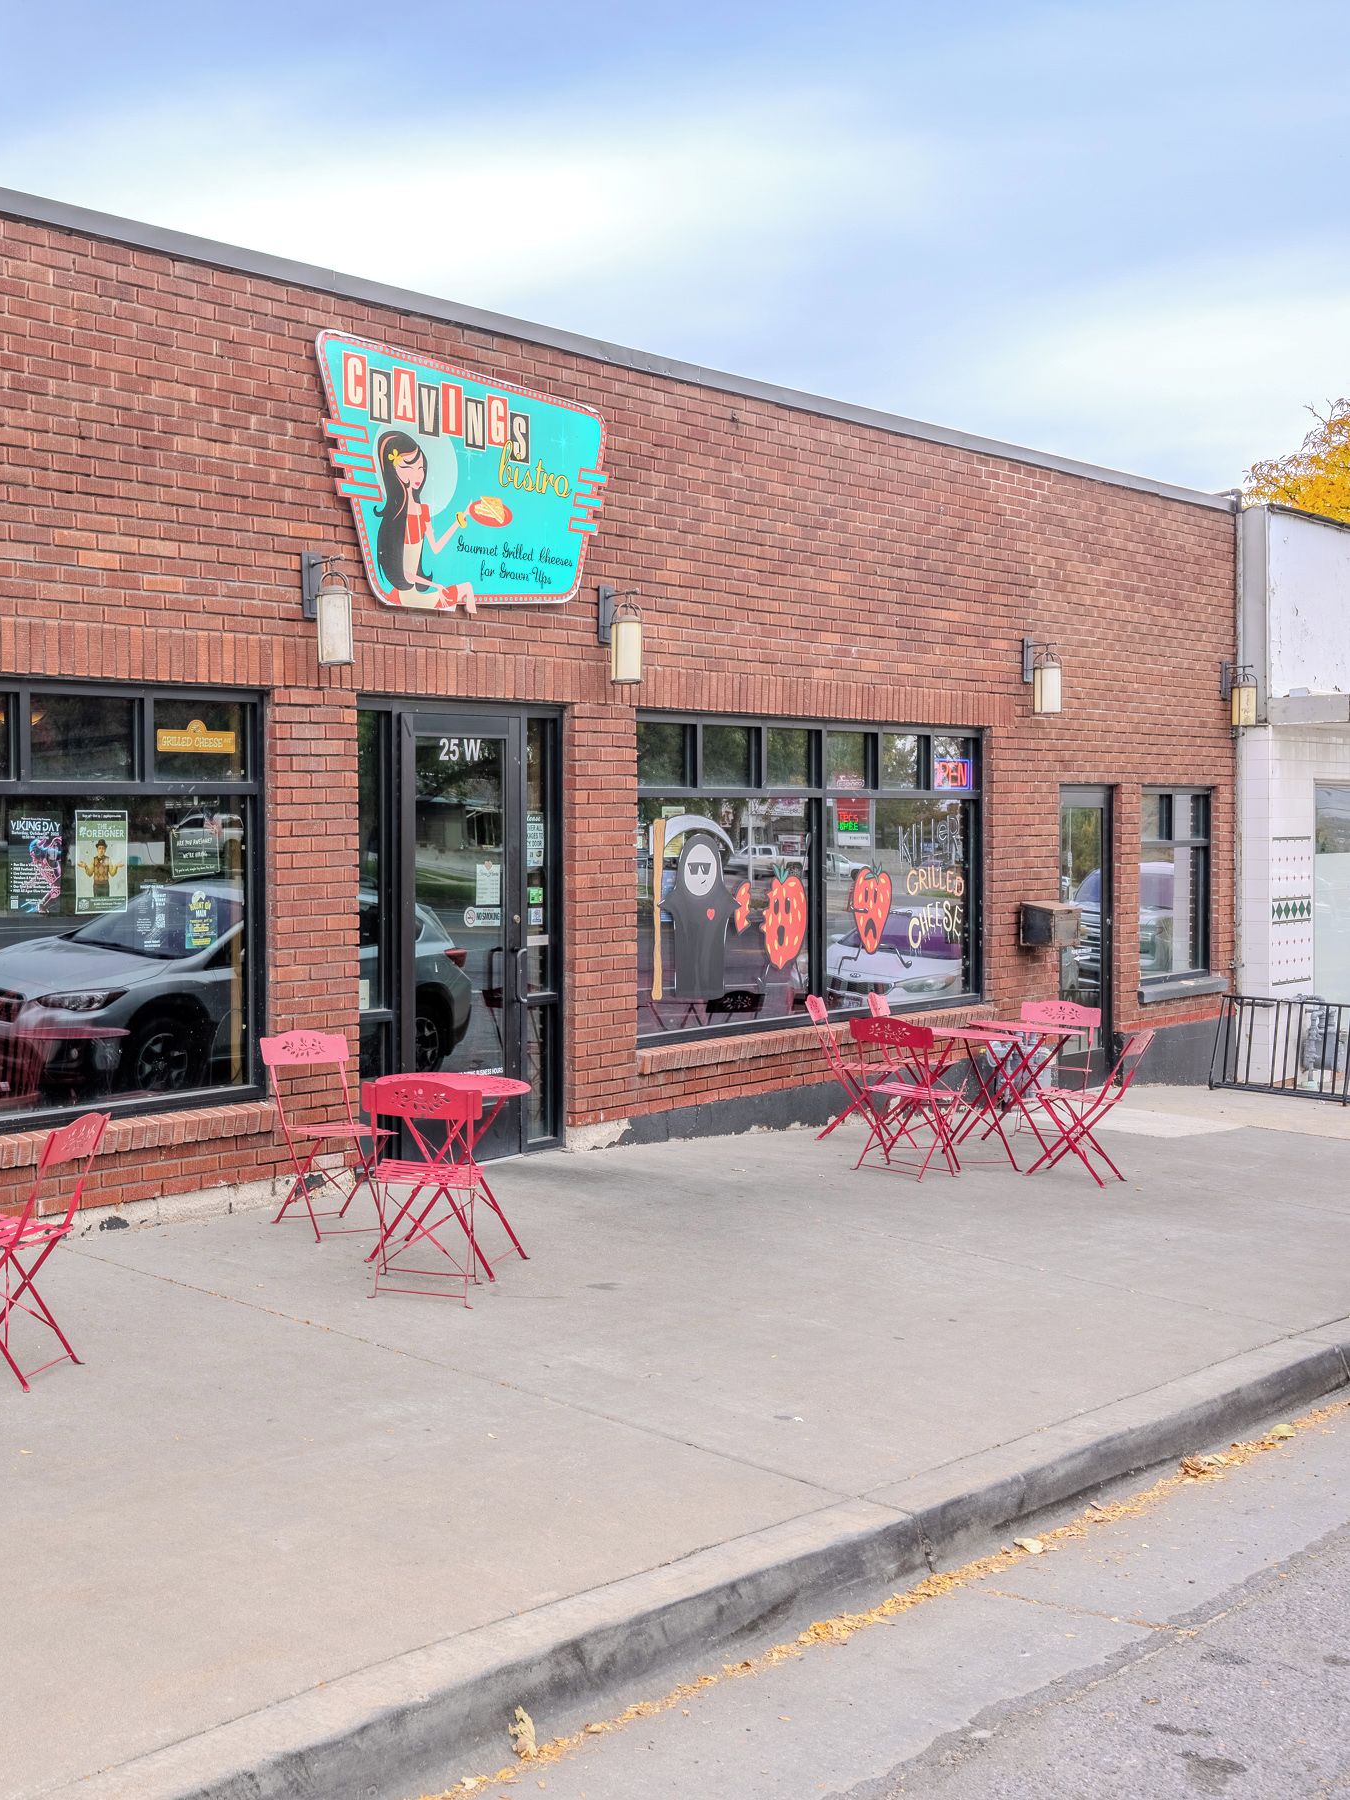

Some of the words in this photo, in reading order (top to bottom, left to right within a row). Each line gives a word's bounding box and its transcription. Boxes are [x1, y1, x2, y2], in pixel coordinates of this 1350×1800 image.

[347, 356, 527, 461] CRAVINGS
[498, 440, 573, 498] bistro
[457, 535, 498, 557] Gourmet
[502, 541, 534, 562] Grilled
[539, 546, 573, 567] Cheeses
[480, 560, 495, 582] for
[161, 736, 193, 747] GRILLED
[194, 737, 223, 748] CHEESE
[439, 738, 460, 761] 25
[463, 738, 482, 761] W
[10, 820, 41, 831] VIKING
[42, 821, 60, 832] DAY
[79, 826, 125, 838] FOREIGNER
[906, 864, 965, 897] GRILLED
[476, 912, 482, 920] NO
[482, 912, 500, 920] SMOKING
[908, 900, 964, 951] CHEESE
